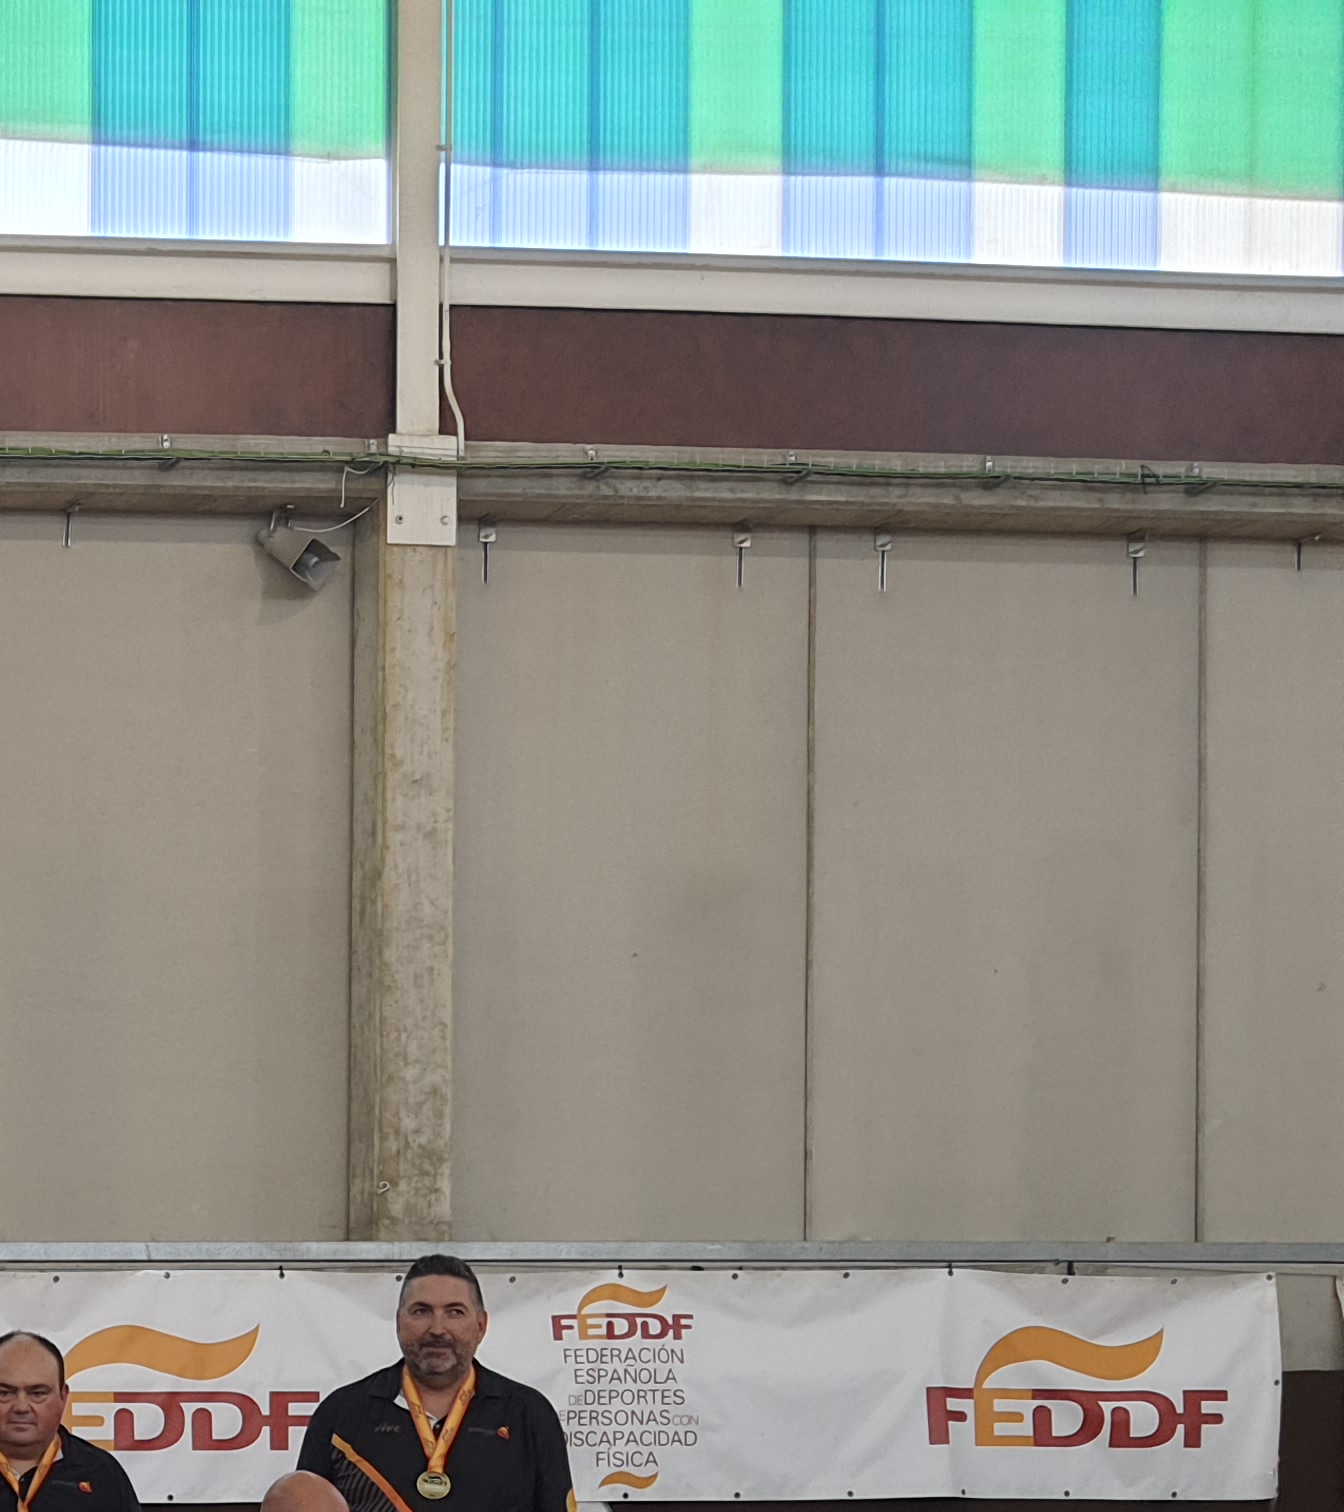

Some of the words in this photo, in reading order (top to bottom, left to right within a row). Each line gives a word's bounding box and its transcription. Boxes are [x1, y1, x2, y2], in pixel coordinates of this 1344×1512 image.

[551, 1312, 694, 1341] FEDDF
[563, 1344, 685, 1365] FEDERACIÓN
[574, 1364, 678, 1385] ESPAÑOLA
[584, 1389, 686, 1405] DEPORTES
[64, 1390, 321, 1452] EDDF
[566, 1409, 671, 1427] PERSONAS
[672, 1414, 699, 1426] CON
[925, 1386, 1229, 1449] FEDDF
[596, 1446, 658, 1468] FÍSICA
